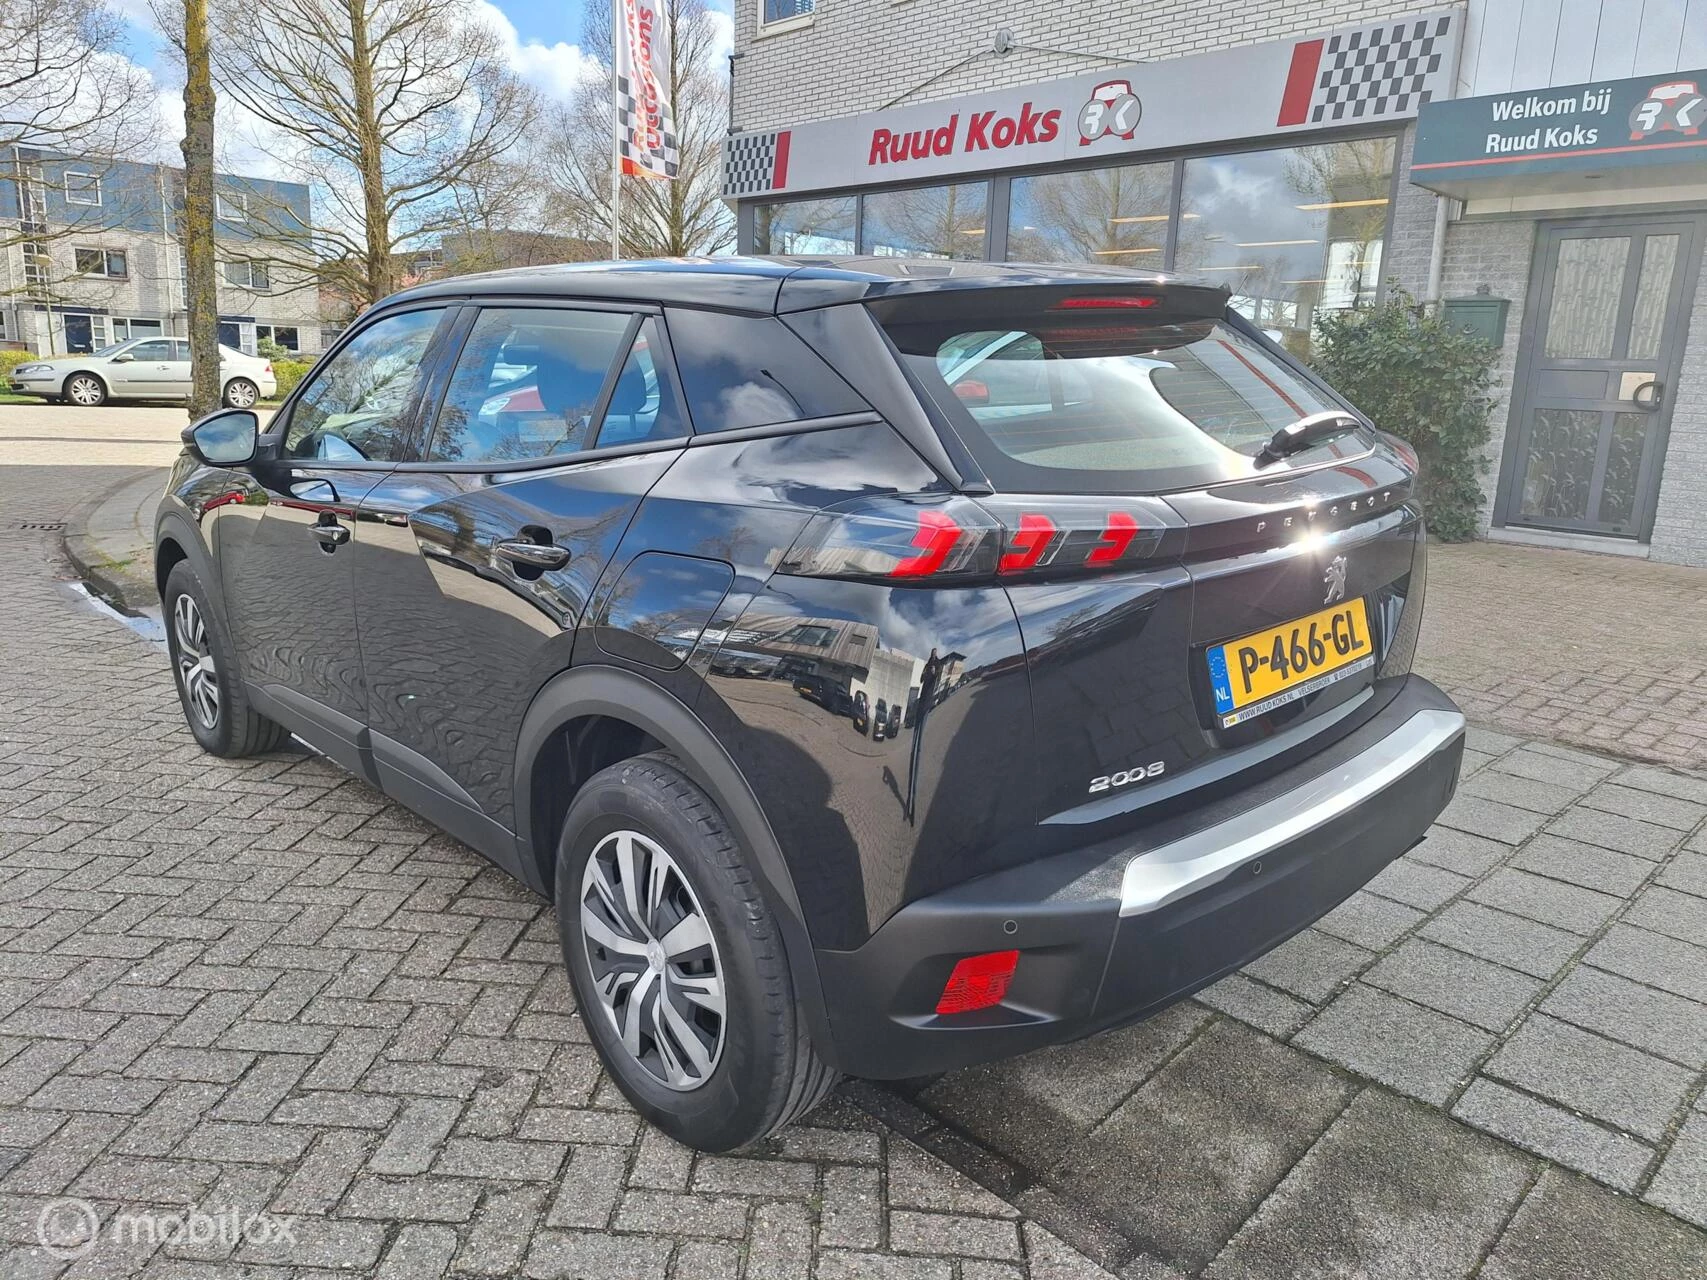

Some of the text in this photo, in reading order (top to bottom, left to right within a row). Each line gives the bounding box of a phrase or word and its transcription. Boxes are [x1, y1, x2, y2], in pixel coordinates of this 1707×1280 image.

[1492, 88, 1613, 122] Welkom bij
[868, 102, 1062, 166] Ruud Koks
[1485, 124, 1599, 153] Ruud Koks
[1238, 610, 1364, 694] P-466-GL
[1215, 686, 1230, 703] NL
[1088, 760, 1165, 794] 2008
